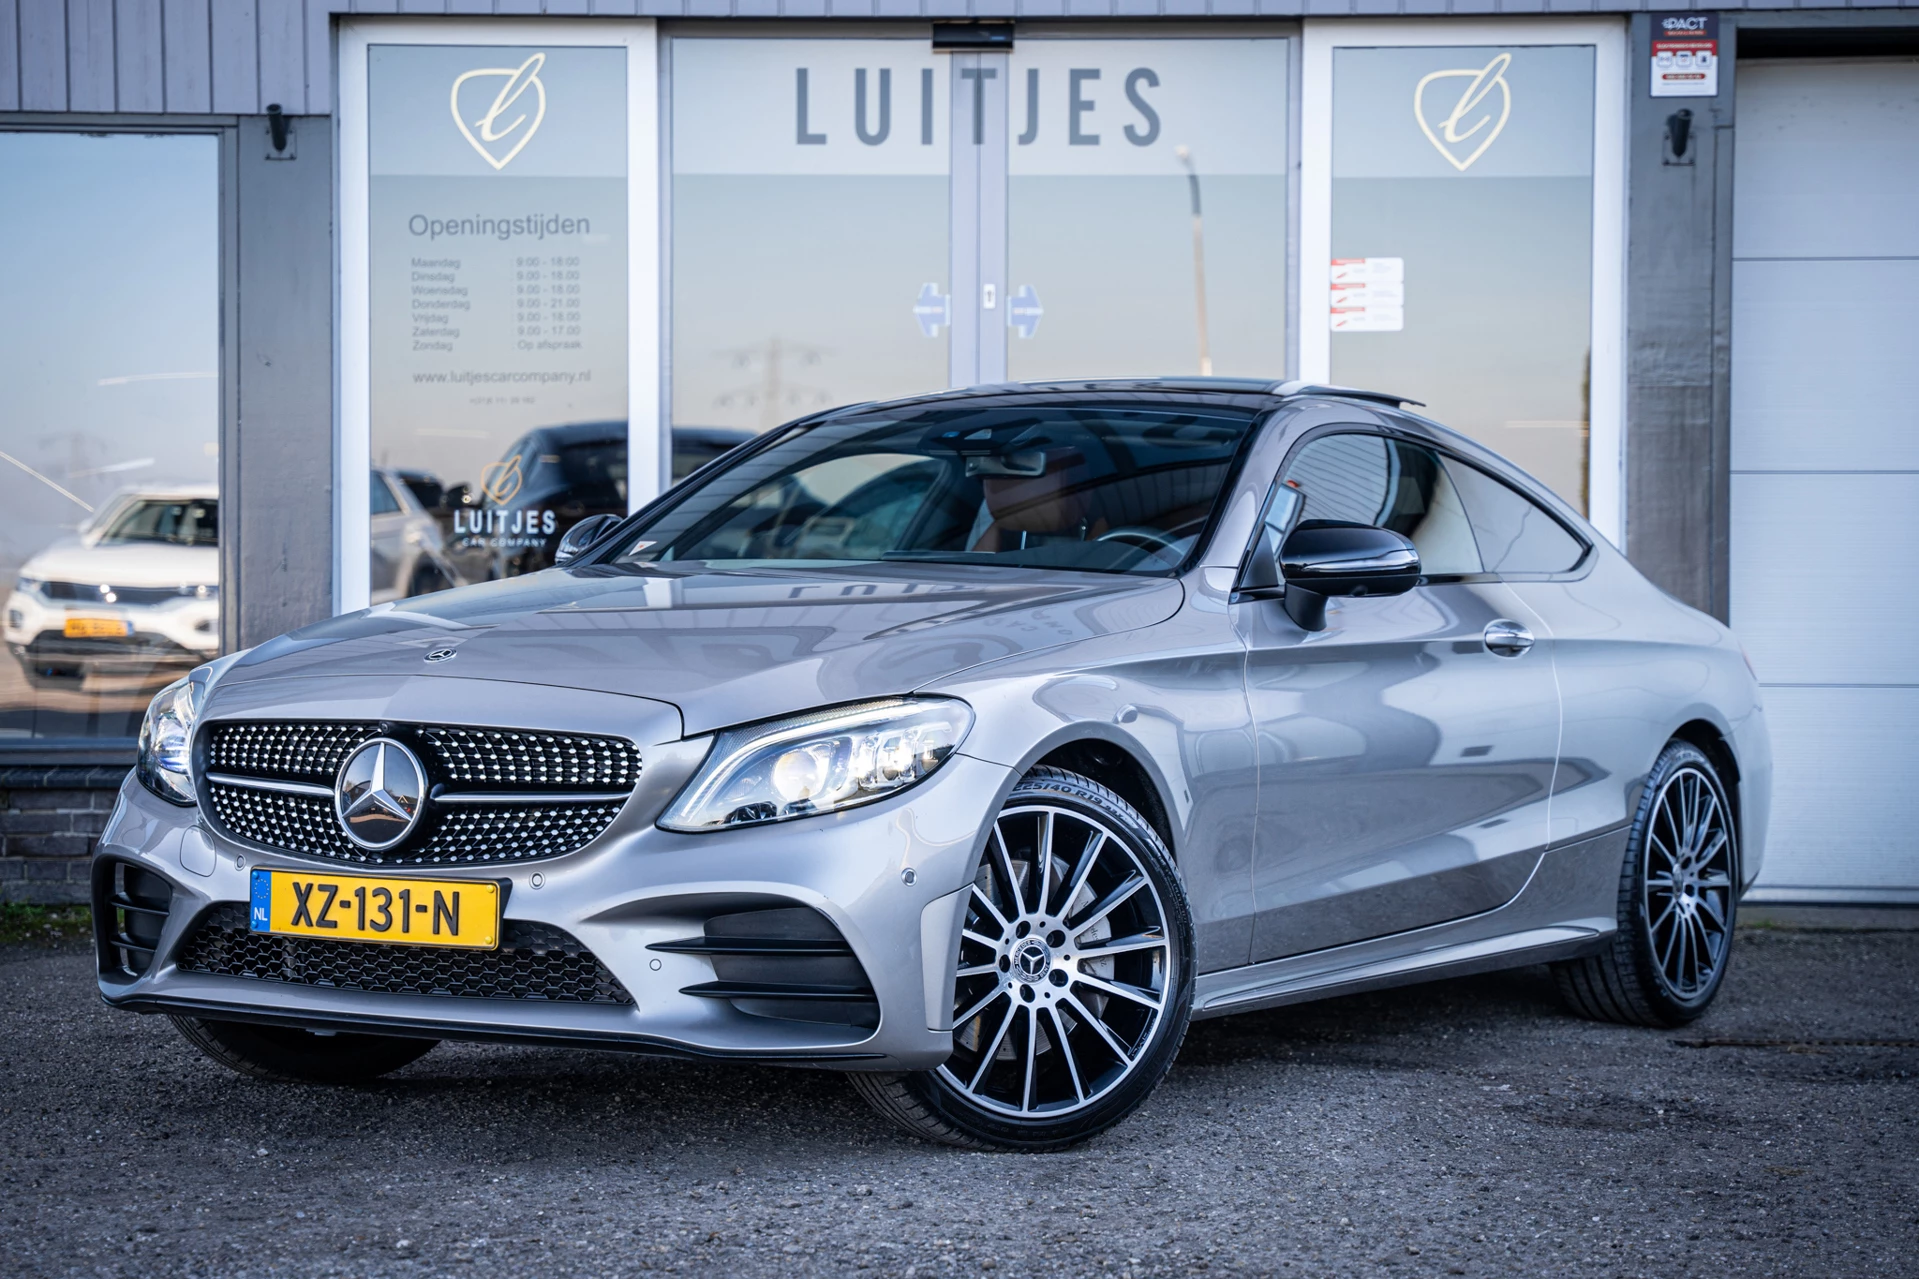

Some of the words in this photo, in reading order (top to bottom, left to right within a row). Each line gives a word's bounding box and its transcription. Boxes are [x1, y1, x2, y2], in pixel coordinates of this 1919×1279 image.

[795, 67, 1161, 147] LUITJES
[408, 213, 591, 242] Openingstijden
[411, 257, 461, 270] Maandag
[411, 271, 455, 284] Dinsdag
[411, 285, 468, 298] Woensdag
[411, 299, 471, 312] Donderdag
[411, 312, 449, 326] Vrijdag
[411, 326, 461, 340] Zaterdag
[411, 340, 454, 353] Zondag
[517, 339, 534, 351] Op
[536, 338, 583, 351] afspraak
[412, 369, 592, 387] www.luitjescarcompany.nl
[454, 509, 556, 535] LUITJES
[462, 537, 485, 547] CAR
[490, 537, 547, 548] COMPANY
[253, 906, 268, 921] NL
[291, 882, 460, 936] XZ-131-N
